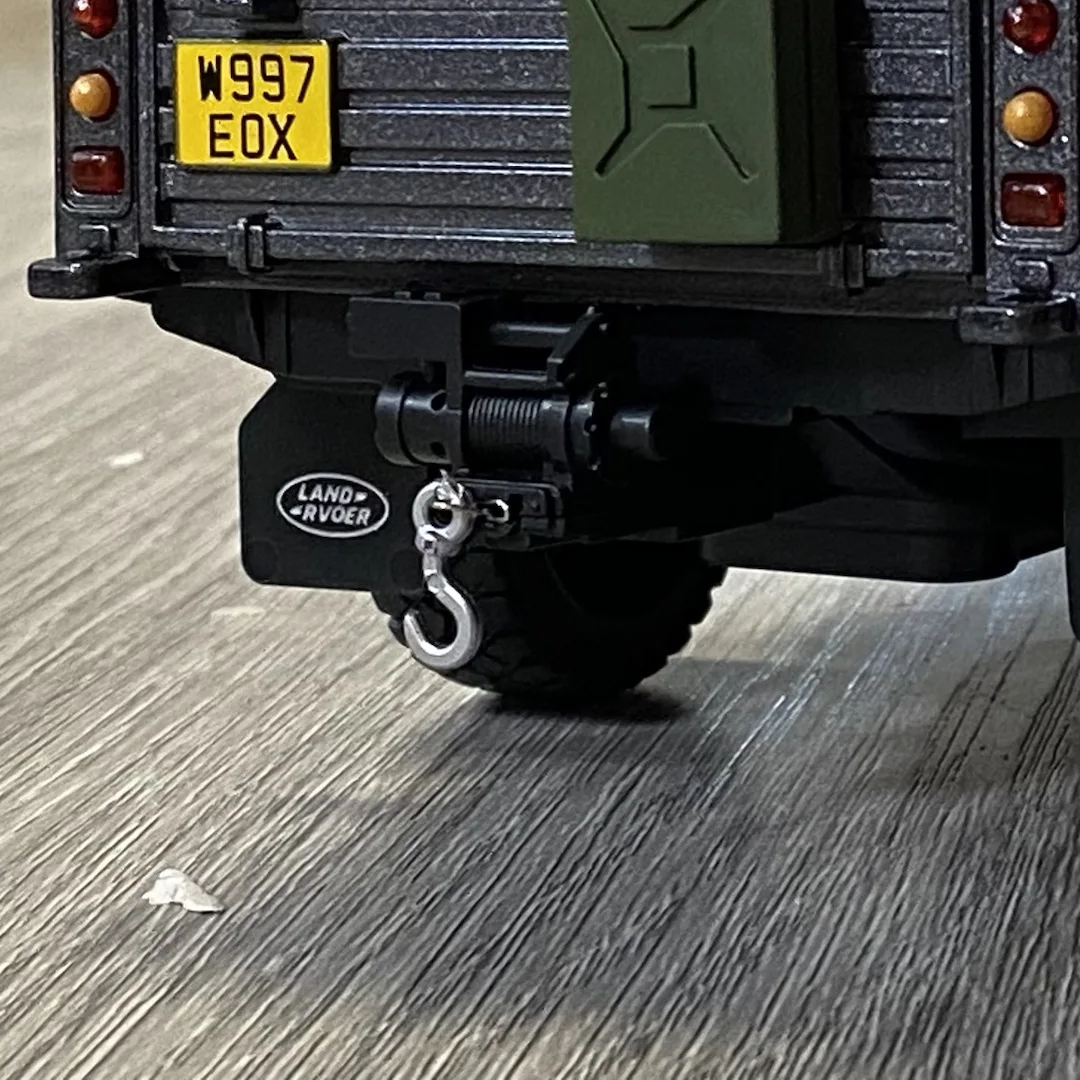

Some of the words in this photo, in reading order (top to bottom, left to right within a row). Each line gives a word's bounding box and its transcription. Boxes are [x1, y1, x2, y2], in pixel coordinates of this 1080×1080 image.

[198, 53, 315, 103] W997
[298, 483, 354, 504] LAND
[302, 504, 371, 526] RVOER
